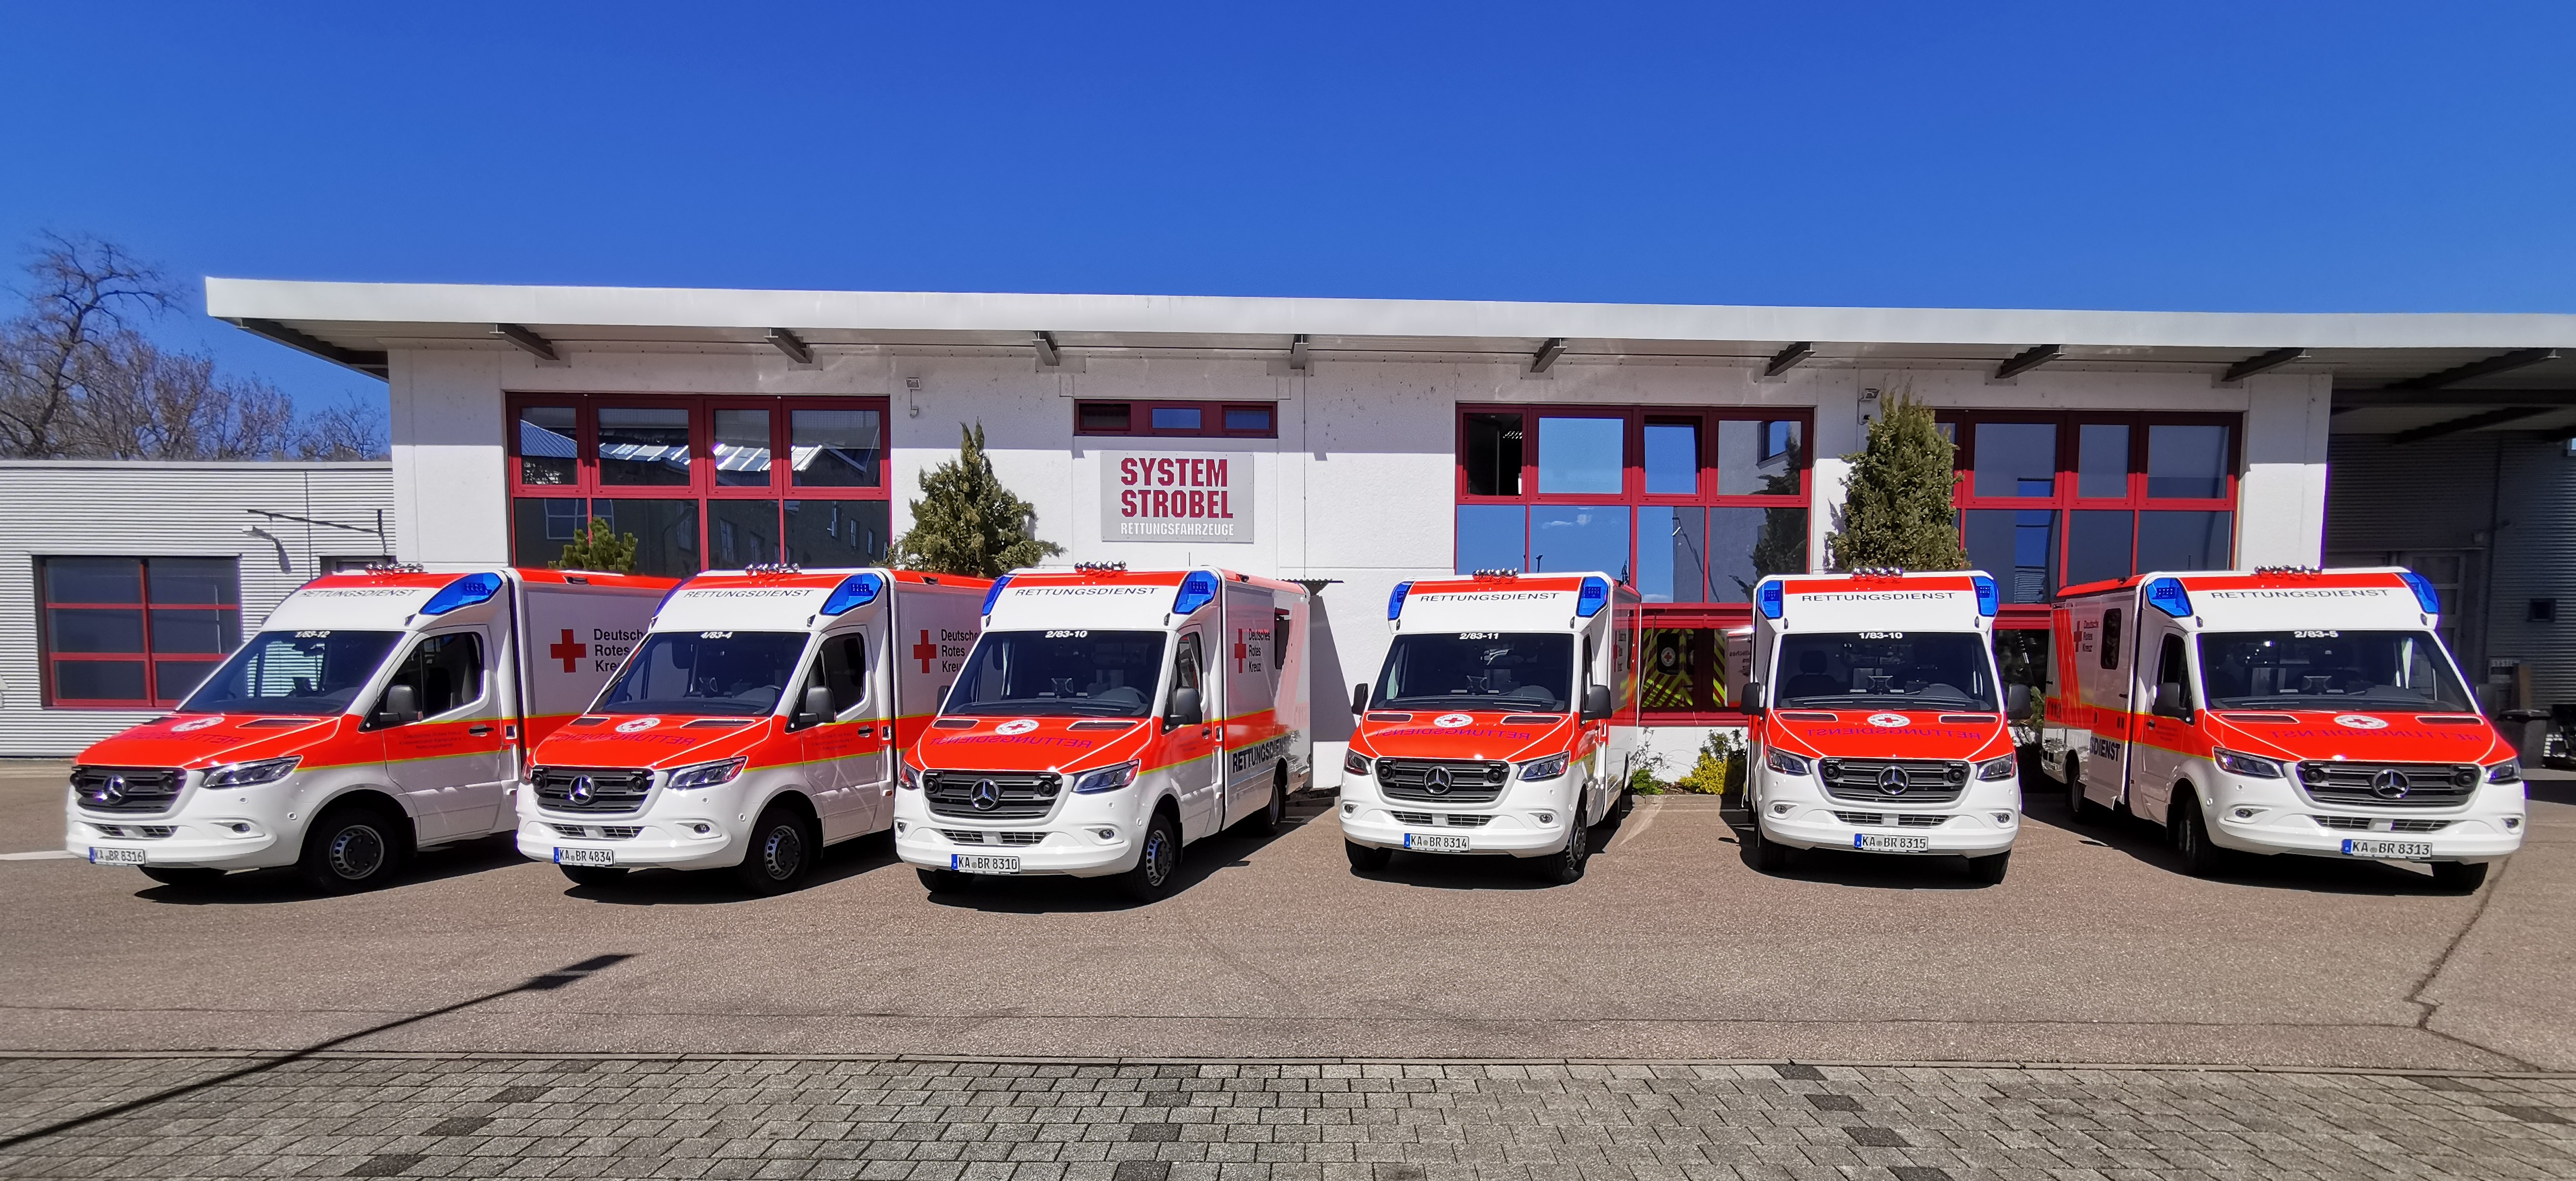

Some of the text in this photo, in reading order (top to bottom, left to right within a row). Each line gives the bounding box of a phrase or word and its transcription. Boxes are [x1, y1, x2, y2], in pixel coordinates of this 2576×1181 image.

[1121, 458, 1228, 487] SYSTEM
[1121, 489, 1234, 519] STROBEL
[1120, 522, 1234, 536] RETTUNGSFAHRZEUGE
[300, 589, 420, 597] RETTUNGSDIENST
[684, 590, 814, 598] RETTUNGSDIENST
[1015, 588, 1159, 596] RETTUNGSDIENST
[1420, 593, 1560, 601] RETTUNGSDIENST
[1802, 592, 1955, 601] RETTUNGSDIENST
[2211, 589, 2389, 598] RETTUNGSDIENST
[594, 629, 646, 641] Deutsch
[1045, 630, 1087, 638] 2/83-10
[595, 644, 630, 657] Rotes
[942, 645, 965, 657] Rotes
[1249, 644, 1261, 657] Rotes
[595, 660, 618, 672] Kre
[1249, 661, 1261, 672] Kreuz
[1411, 836, 1467, 848] KA BR 8314
[1863, 836, 1875, 846] KA
[1884, 837, 1897, 847] BR
[1900, 838, 1925, 848] 8315
[2353, 842, 2430, 855] KA BR 8313
[109, 850, 119, 861] BR
[121, 851, 143, 862] 8316
[560, 849, 611, 862] KA BR 4834
[959, 857, 970, 868] KA
[978, 858, 990, 869] BR
[993, 859, 1017, 869] 8310
